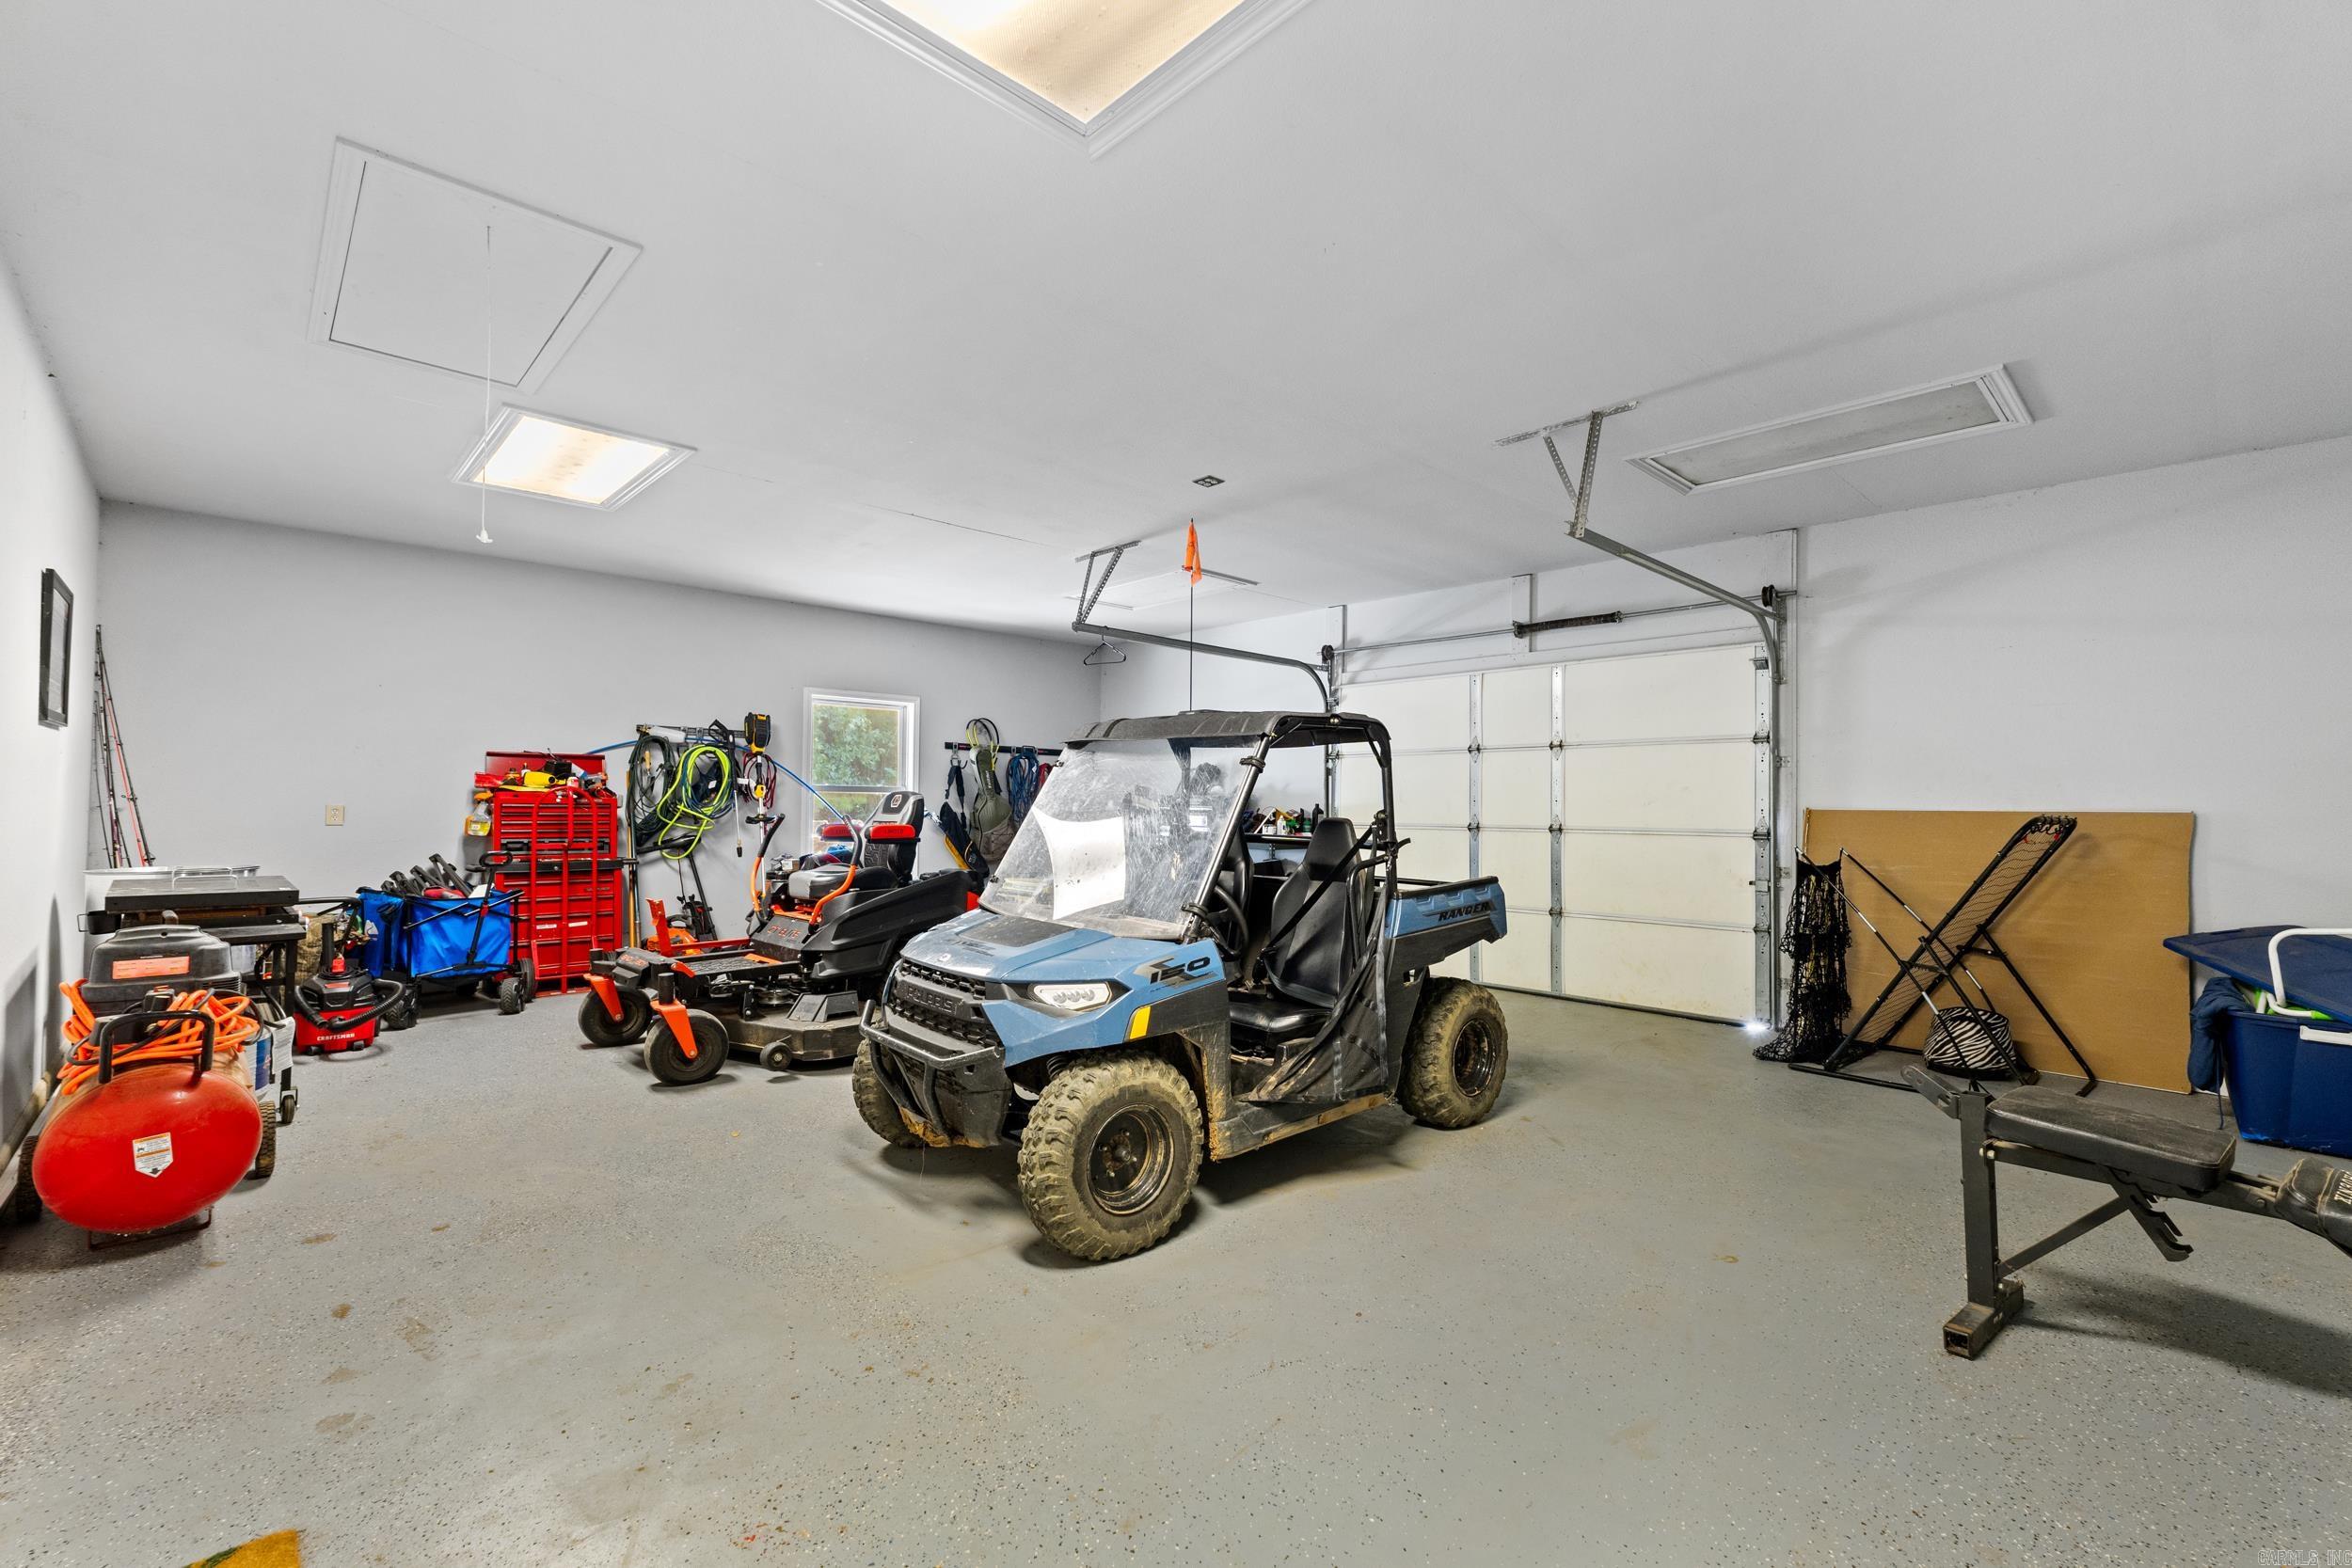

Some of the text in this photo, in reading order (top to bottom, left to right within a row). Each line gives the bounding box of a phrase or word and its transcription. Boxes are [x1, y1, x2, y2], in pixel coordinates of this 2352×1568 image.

[1438, 901, 1488, 922] RANGER
[1150, 956, 1211, 985] 150
[316, 1033, 356, 1041] CRAFTSMAN
